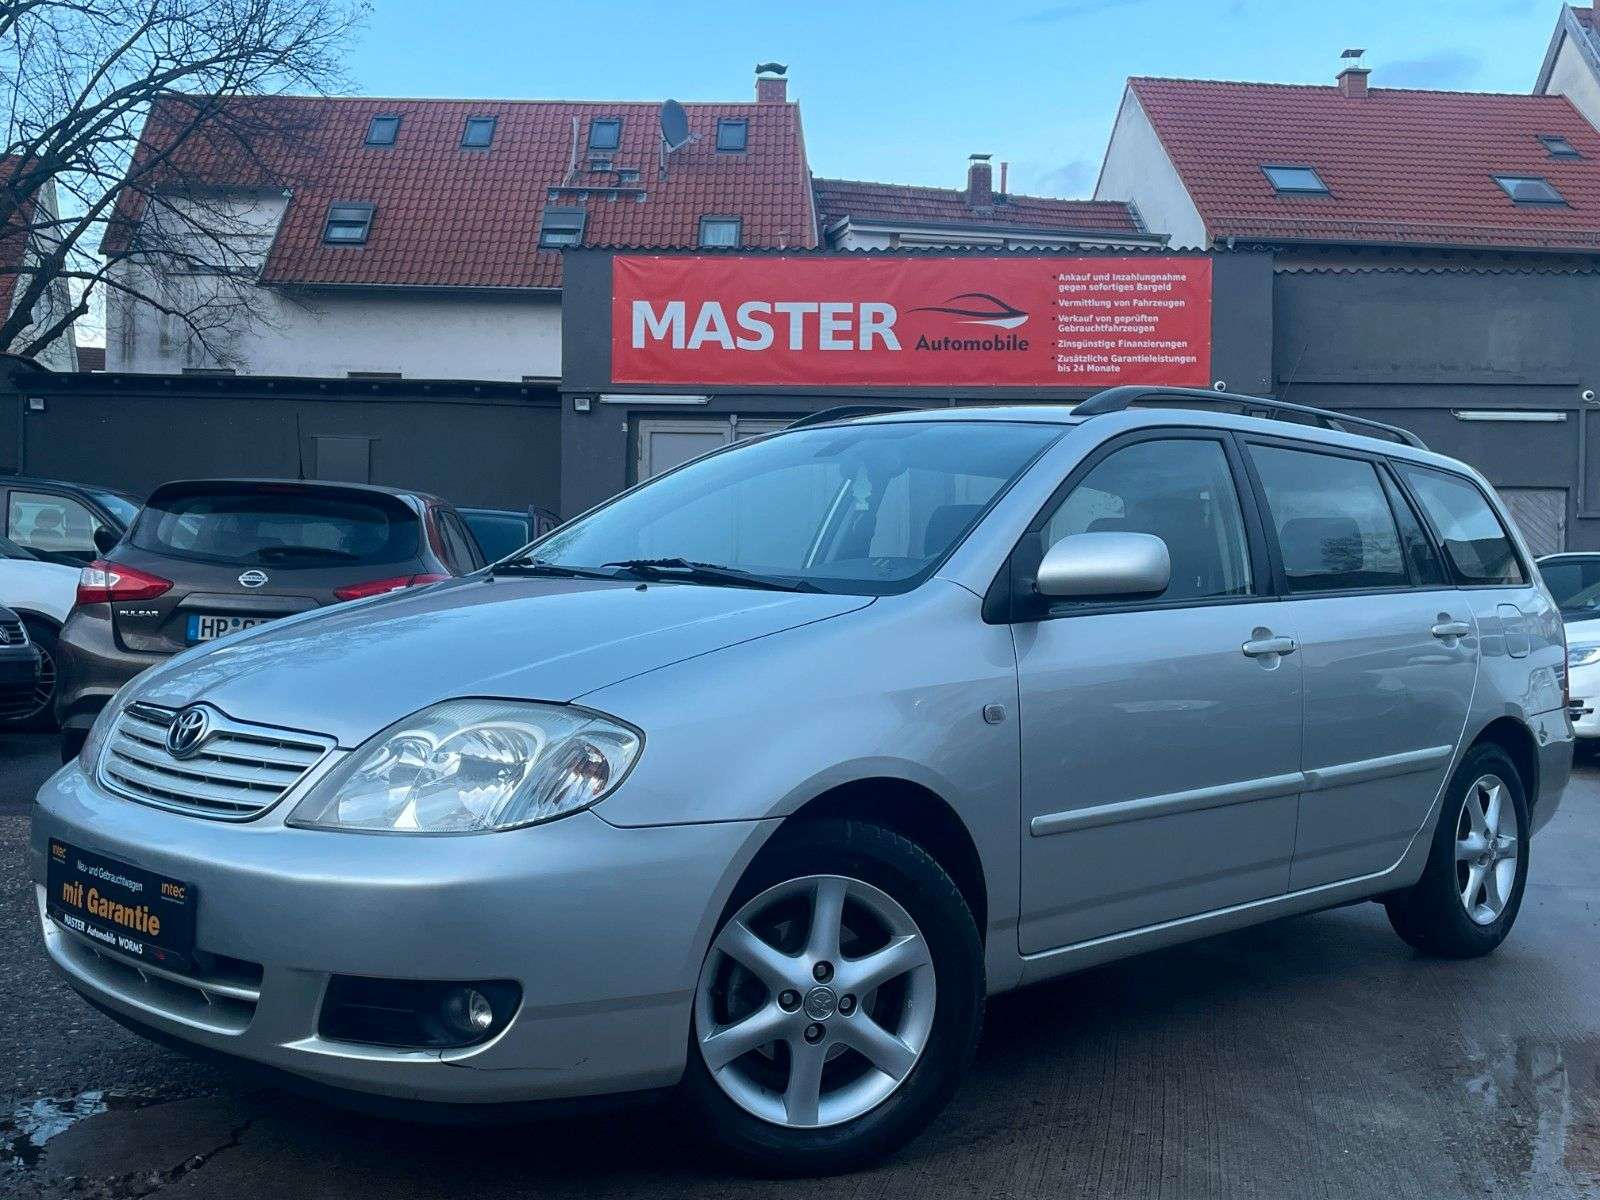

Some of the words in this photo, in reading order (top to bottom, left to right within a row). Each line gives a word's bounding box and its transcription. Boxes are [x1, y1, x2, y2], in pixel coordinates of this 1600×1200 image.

[1058, 273, 1091, 281] Ankauf
[1093, 273, 1110, 281] und
[1112, 273, 1187, 283] Inzahlungnahme
[1058, 284, 1087, 293] gegen
[1088, 283, 1135, 292] sofortiges
[1136, 283, 1172, 293] Bargeld
[1058, 299, 1112, 309] Vermittlung
[1132, 299, 1186, 309] Fahrzeugen
[1114, 315, 1159, 325] geprüften
[631, 300, 902, 352] MASTER
[1058, 324, 1156, 334] Gebrauchtfahrzeugen
[914, 334, 1030, 353] Automobile
[1057, 340, 1116, 350] Zinsgünstige
[1118, 340, 1188, 350] Finanzierungen
[1057, 354, 1109, 362] Zusätzliche
[1110, 354, 1197, 364] Garantieleistungen
[1057, 364, 1071, 372] bis
[1073, 364, 1084, 372] 24
[1086, 365, 1121, 373] Monate
[119, 609, 159, 617] PULSAR
[201, 618, 228, 638] HP
[88, 866, 99, 877] und
[99, 868, 143, 893] Gebrauchtwagen
[63, 881, 83, 909] mit
[87, 887, 160, 936] Garantie
[64, 913, 85, 932] MASTER
[87, 925, 116, 945] Automobile
[118, 936, 143, 955] WORMS
